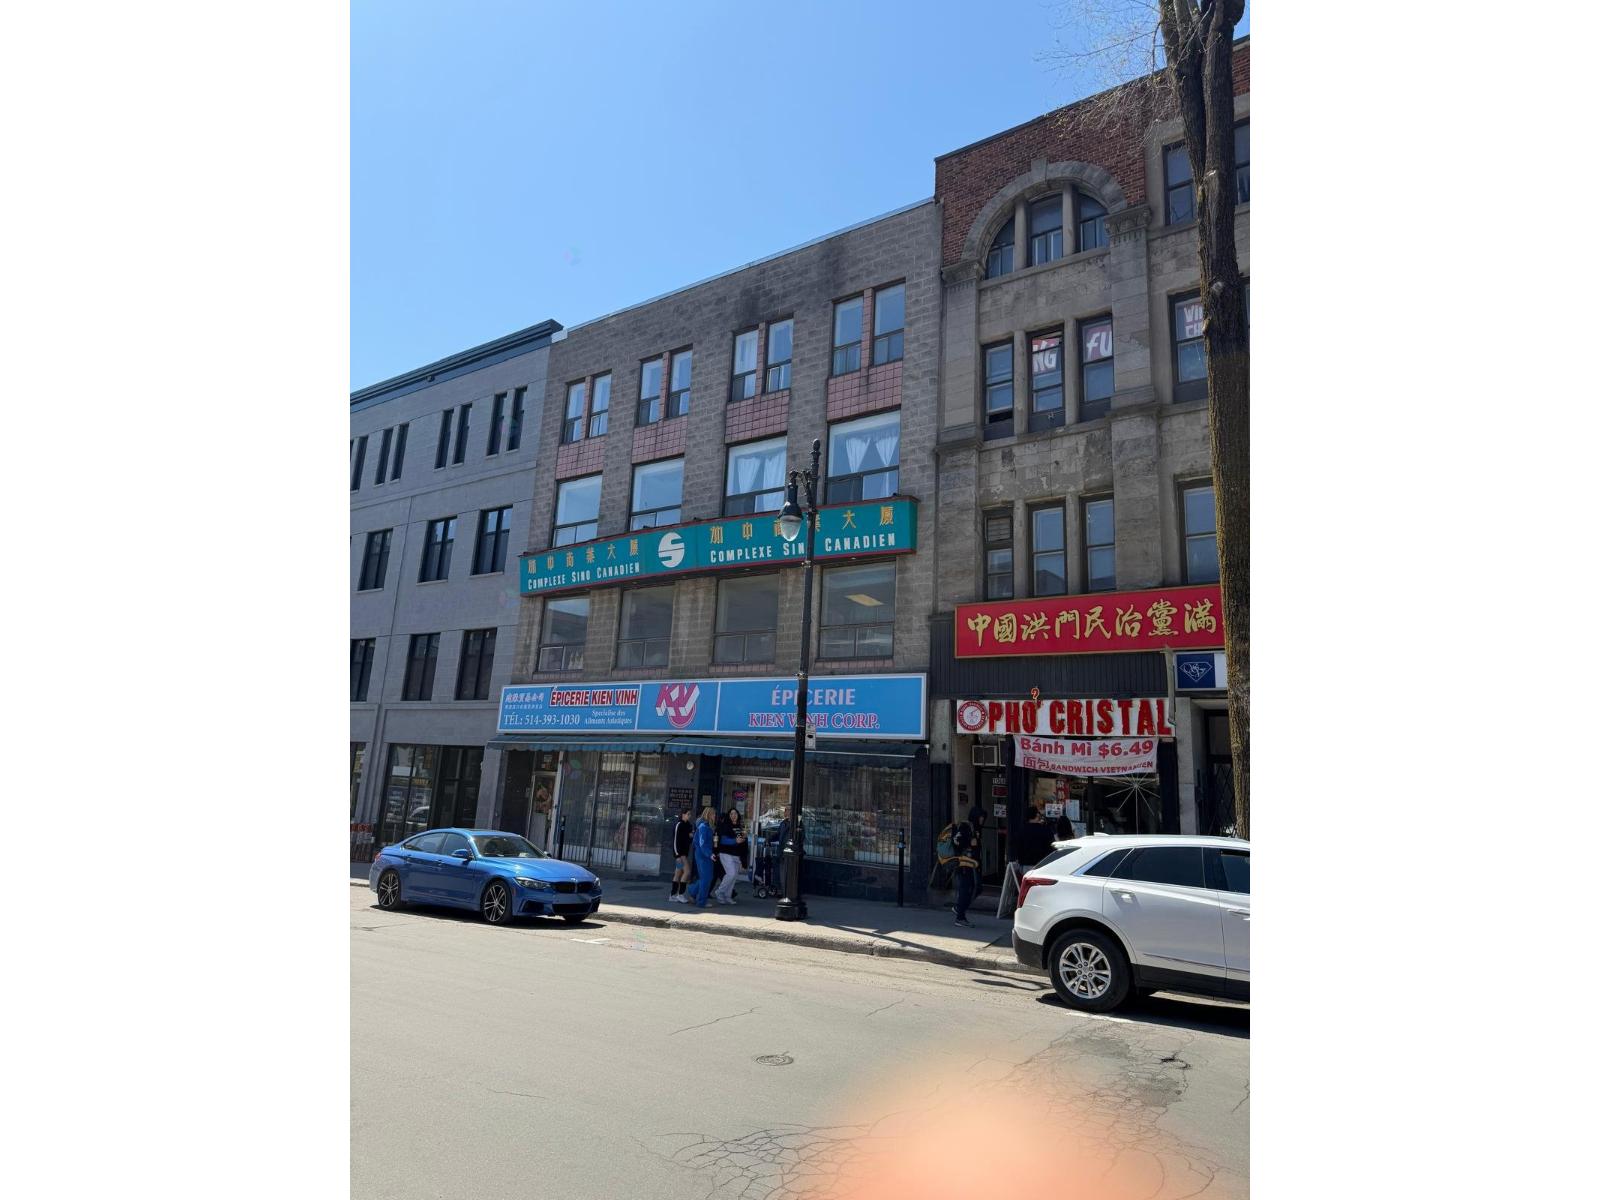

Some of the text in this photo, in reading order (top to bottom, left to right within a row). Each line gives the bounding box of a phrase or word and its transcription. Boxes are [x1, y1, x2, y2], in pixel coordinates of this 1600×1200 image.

[710, 533, 895, 563] COMPLEXE SIN CANADIEN
[528, 562, 640, 590] COMPLEXE SINO CANADIEN
[549, 685, 639, 707] ÉPICERIE KIEN VINH
[504, 712, 580, 725] TÉL: 514-393-1030
[748, 712, 880, 729] KIEN VNH CORP.
[1050, 698, 1172, 736] CRISTAL
[1021, 737, 1064, 754] Bánh
[1098, 740, 1153, 759] $6.49
[1051, 763, 1099, 773] SANDWICH
